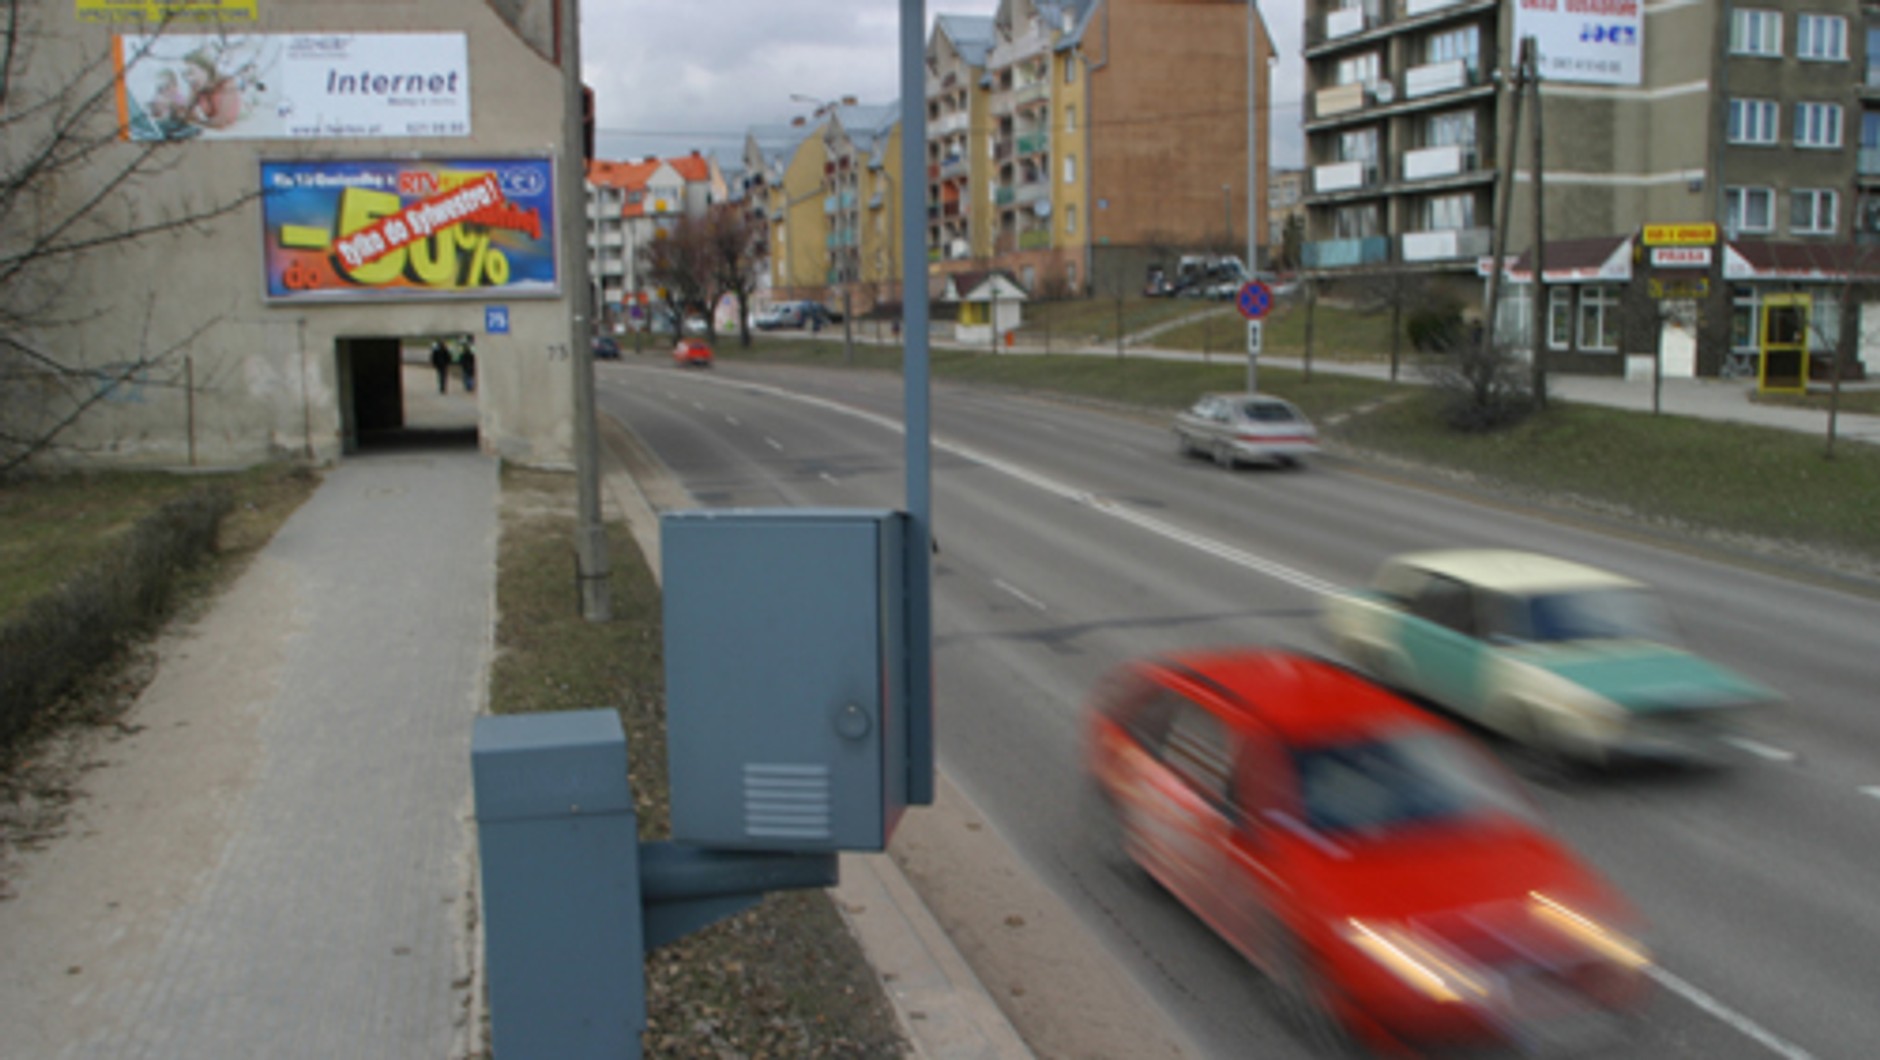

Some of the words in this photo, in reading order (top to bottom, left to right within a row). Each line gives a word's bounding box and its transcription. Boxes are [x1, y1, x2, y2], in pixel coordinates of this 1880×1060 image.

[326, 68, 458, 94] Internet
[338, 229, 386, 266] Tylko
[383, 217, 409, 246] do
[1657, 249, 1705, 262] PRASA
